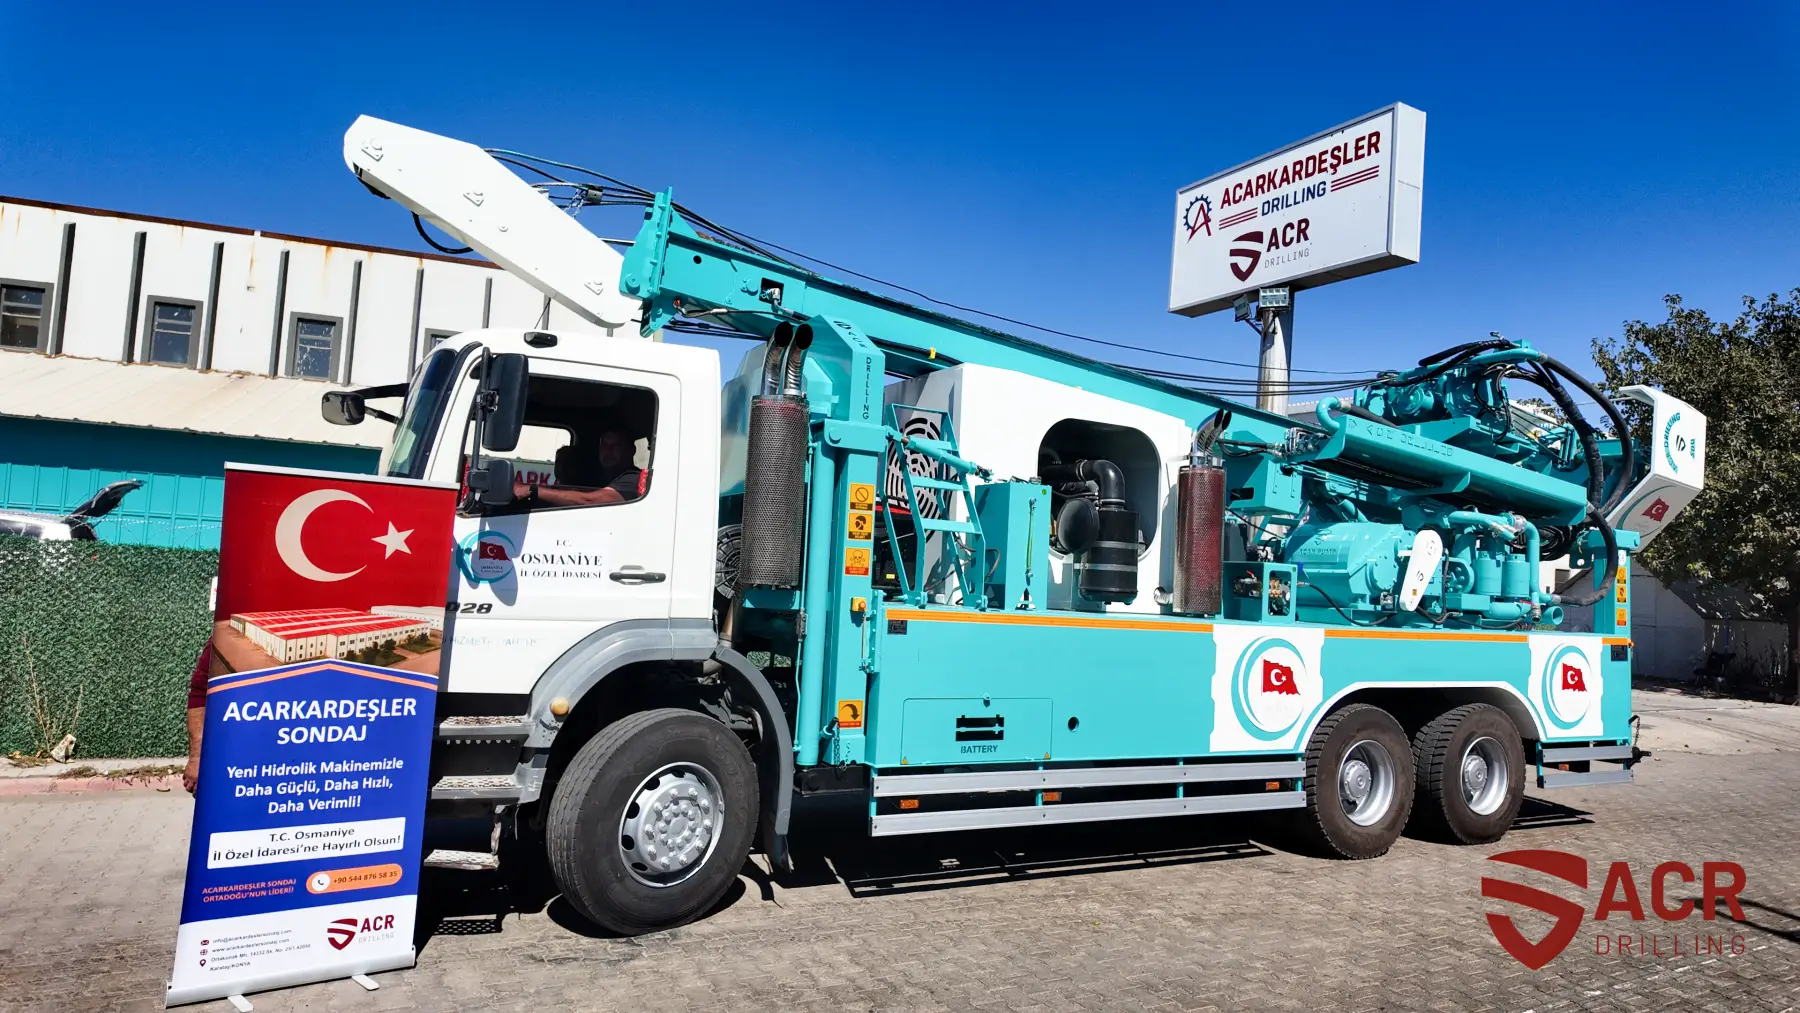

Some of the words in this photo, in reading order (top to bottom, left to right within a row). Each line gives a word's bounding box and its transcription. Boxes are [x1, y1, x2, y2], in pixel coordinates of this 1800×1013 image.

[1220, 131, 1380, 209] ACARKARDEŞLER
[1261, 181, 1326, 216] DRILLING
[1267, 218, 1310, 252] ACR
[1264, 248, 1309, 268] DRILLING
[862, 357, 872, 420] DRILLING
[521, 552, 603, 566] OSMANİYE
[532, 568, 558, 578] ÖZEL
[562, 569, 602, 579] İDARESİ
[223, 698, 417, 721] ACARKARDEŞLER
[277, 725, 367, 744] SONDAJ
[961, 745, 998, 754] BATTERY
[227, 766, 257, 778] Yeni
[262, 761, 317, 777] Hidrolik
[320, 757, 404, 774] Makinemizle
[235, 785, 272, 797] Daha
[276, 780, 320, 795] Güçlü,
[324, 778, 358, 791] Daha
[362, 775, 393, 789] Hızlı,
[268, 801, 304, 814] Daha
[308, 795, 361, 810] Verimli!
[269, 833, 291, 842] T.C.
[295, 828, 355, 841] Osmaniye
[213, 850, 221, 861] İl
[225, 849, 253, 860] Özel
[257, 843, 319, 858] İdaresi'ne
[322, 839, 361, 853] Hayırlı
[364, 835, 401, 847] Olsun!
[363, 873, 377, 881] 876
[389, 870, 398, 878] 35
[202, 882, 266, 895] ACARKARDEŞLER
[267, 879, 297, 888] SONDAJ
[268, 886, 295, 896] LİDERİ!
[360, 914, 395, 933] ACR
[358, 932, 395, 943] DRILLING
